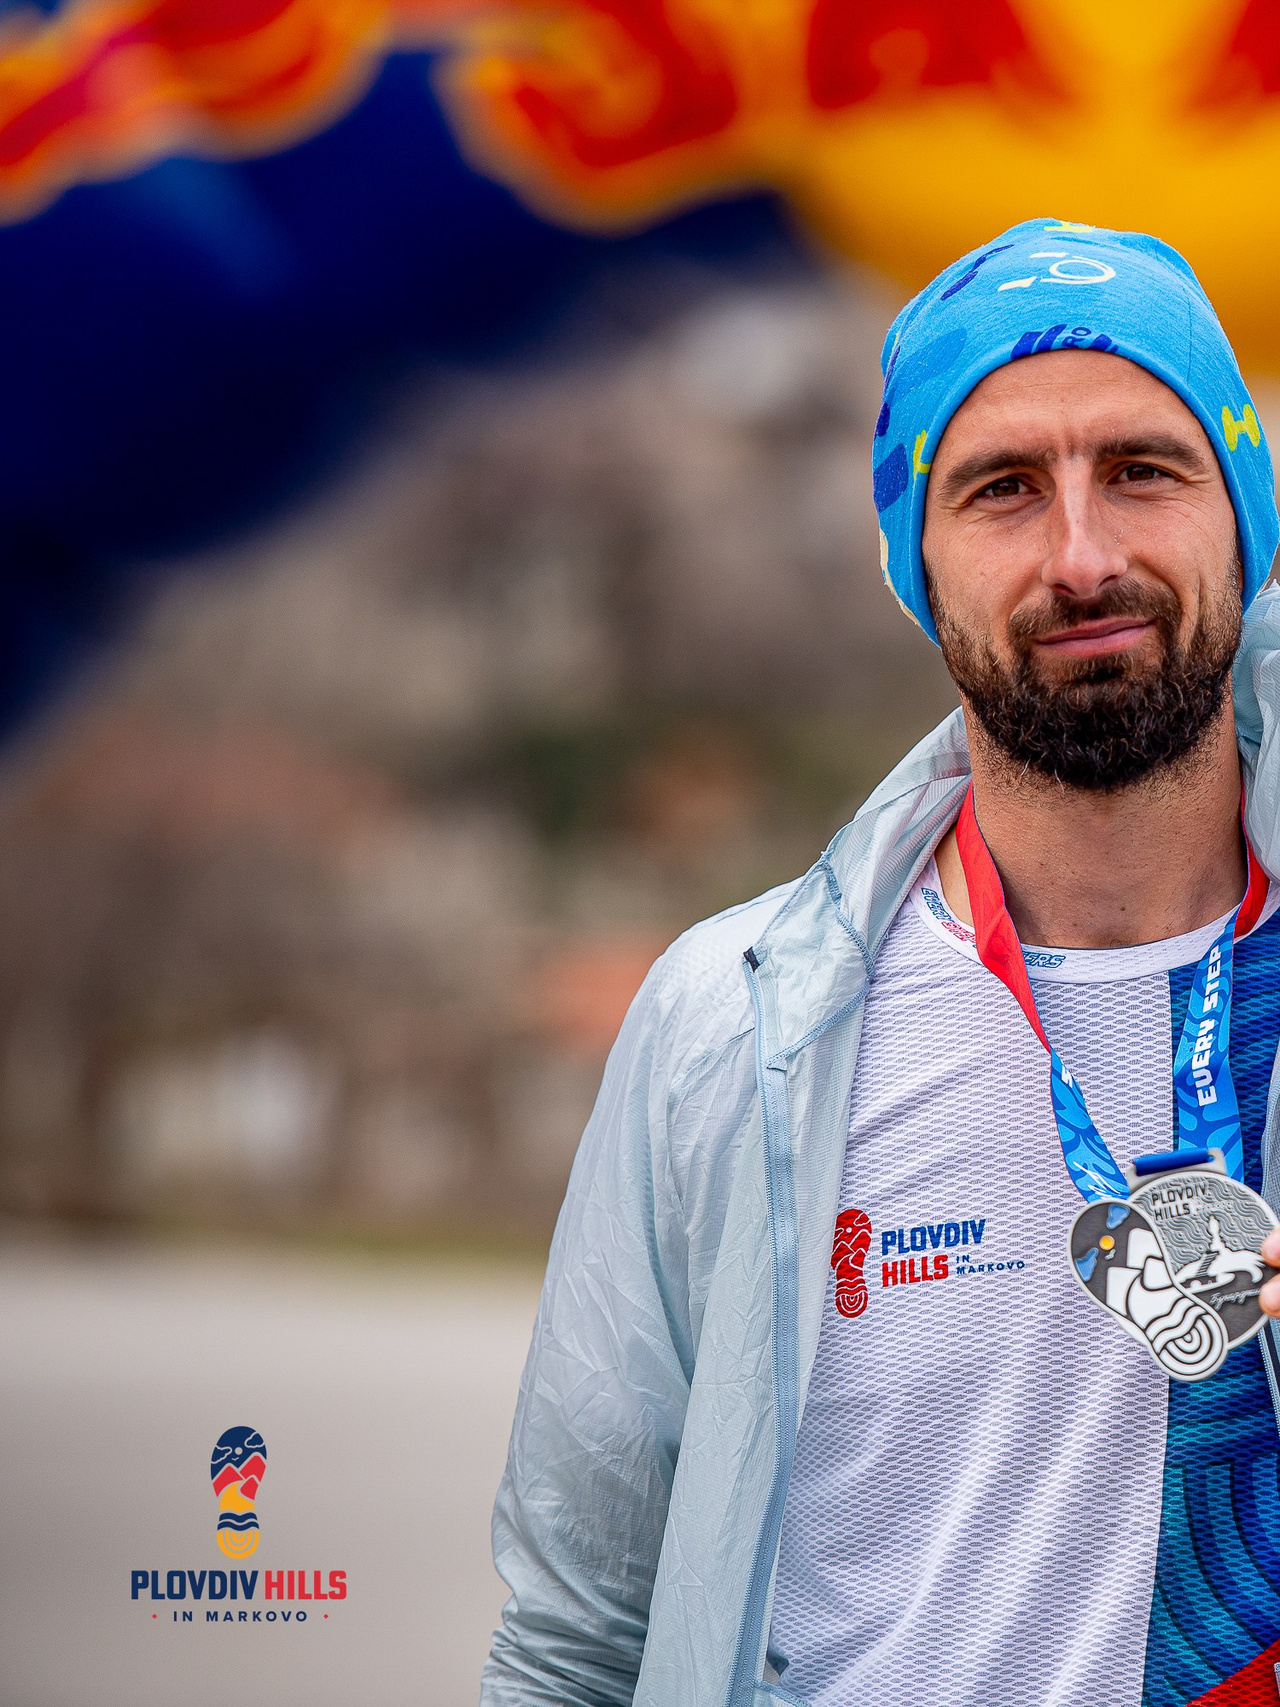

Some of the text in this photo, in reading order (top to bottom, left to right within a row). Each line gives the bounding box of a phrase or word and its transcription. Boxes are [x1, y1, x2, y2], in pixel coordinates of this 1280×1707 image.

[1203, 944, 1222, 1013] STEP
[1151, 1182, 1206, 1206] PLOVDIV
[1154, 1202, 1191, 1221] HILLS
[881, 1218, 987, 1257] PLOVDIV
[881, 1254, 950, 1288] HILLS
[956, 1254, 970, 1264] IN
[956, 1259, 1026, 1275] MARKOVO
